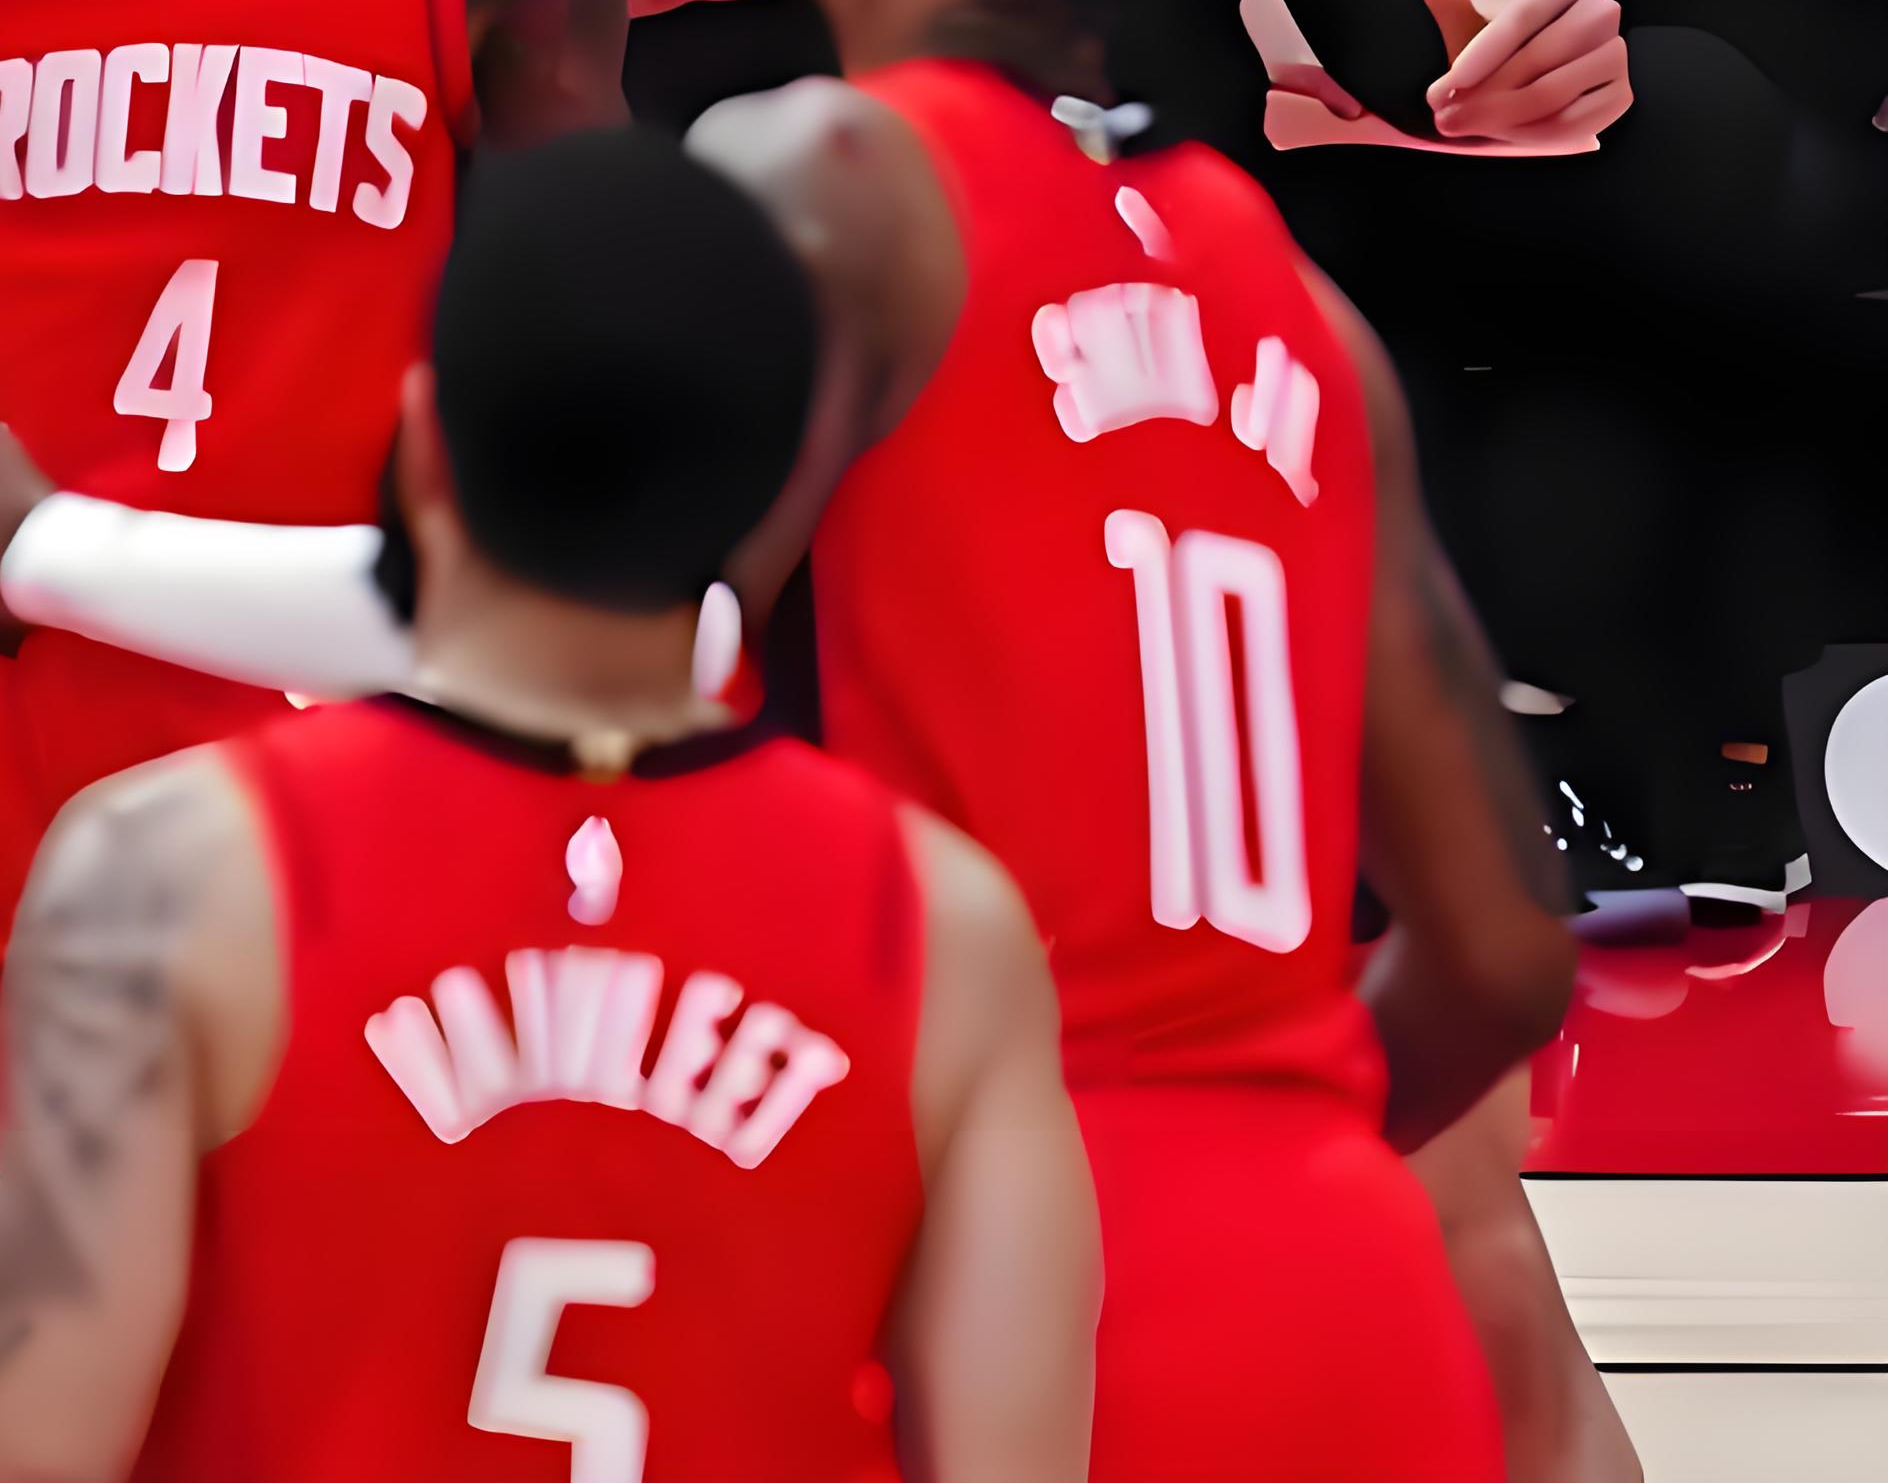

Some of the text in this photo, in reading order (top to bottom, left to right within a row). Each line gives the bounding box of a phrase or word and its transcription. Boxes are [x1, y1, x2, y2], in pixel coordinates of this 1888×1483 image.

[113, 258, 220, 473] 4
[1103, 508, 1313, 955] 10
[466, 1236, 657, 1483] 5
